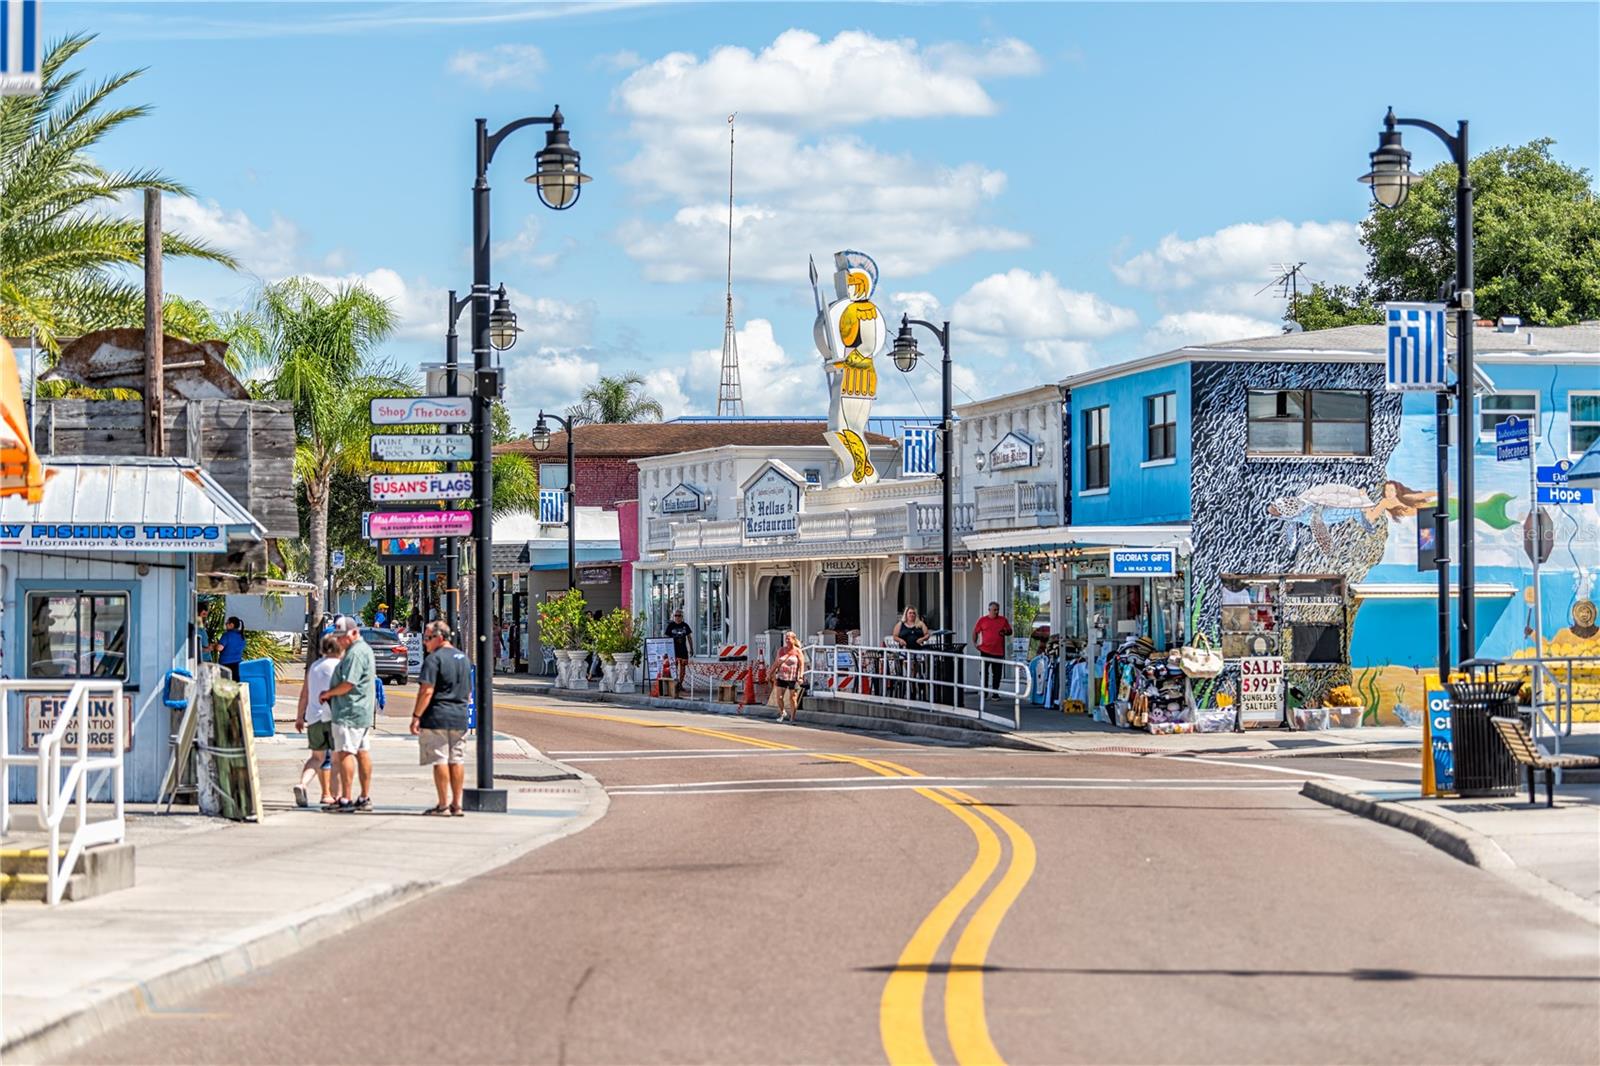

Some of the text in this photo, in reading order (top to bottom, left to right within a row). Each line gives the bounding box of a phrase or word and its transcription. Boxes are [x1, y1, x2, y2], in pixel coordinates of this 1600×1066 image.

[378, 406, 467, 418] Shop The Docks
[421, 445, 457, 457] BAR
[1498, 445, 1528, 459] Dodecanese
[373, 479, 471, 494] SUSAN'S FLAGS
[1550, 488, 1582, 503] Hope
[757, 500, 785, 516] Hellas
[448, 513, 469, 522] Treats
[746, 517, 796, 532] Restaurant
[31, 525, 136, 539] FISHING
[142, 525, 219, 540] TRIPS
[26, 539, 216, 548] Information & Reservations
[1115, 553, 1170, 562] GLORIA'S GIFTS
[826, 561, 856, 569] HELLAS
[1242, 660, 1283, 676] SALE
[1242, 677, 1269, 693] 5.99
[40, 700, 114, 717] FIIN
[1245, 702, 1278, 711] SALTLIFE
